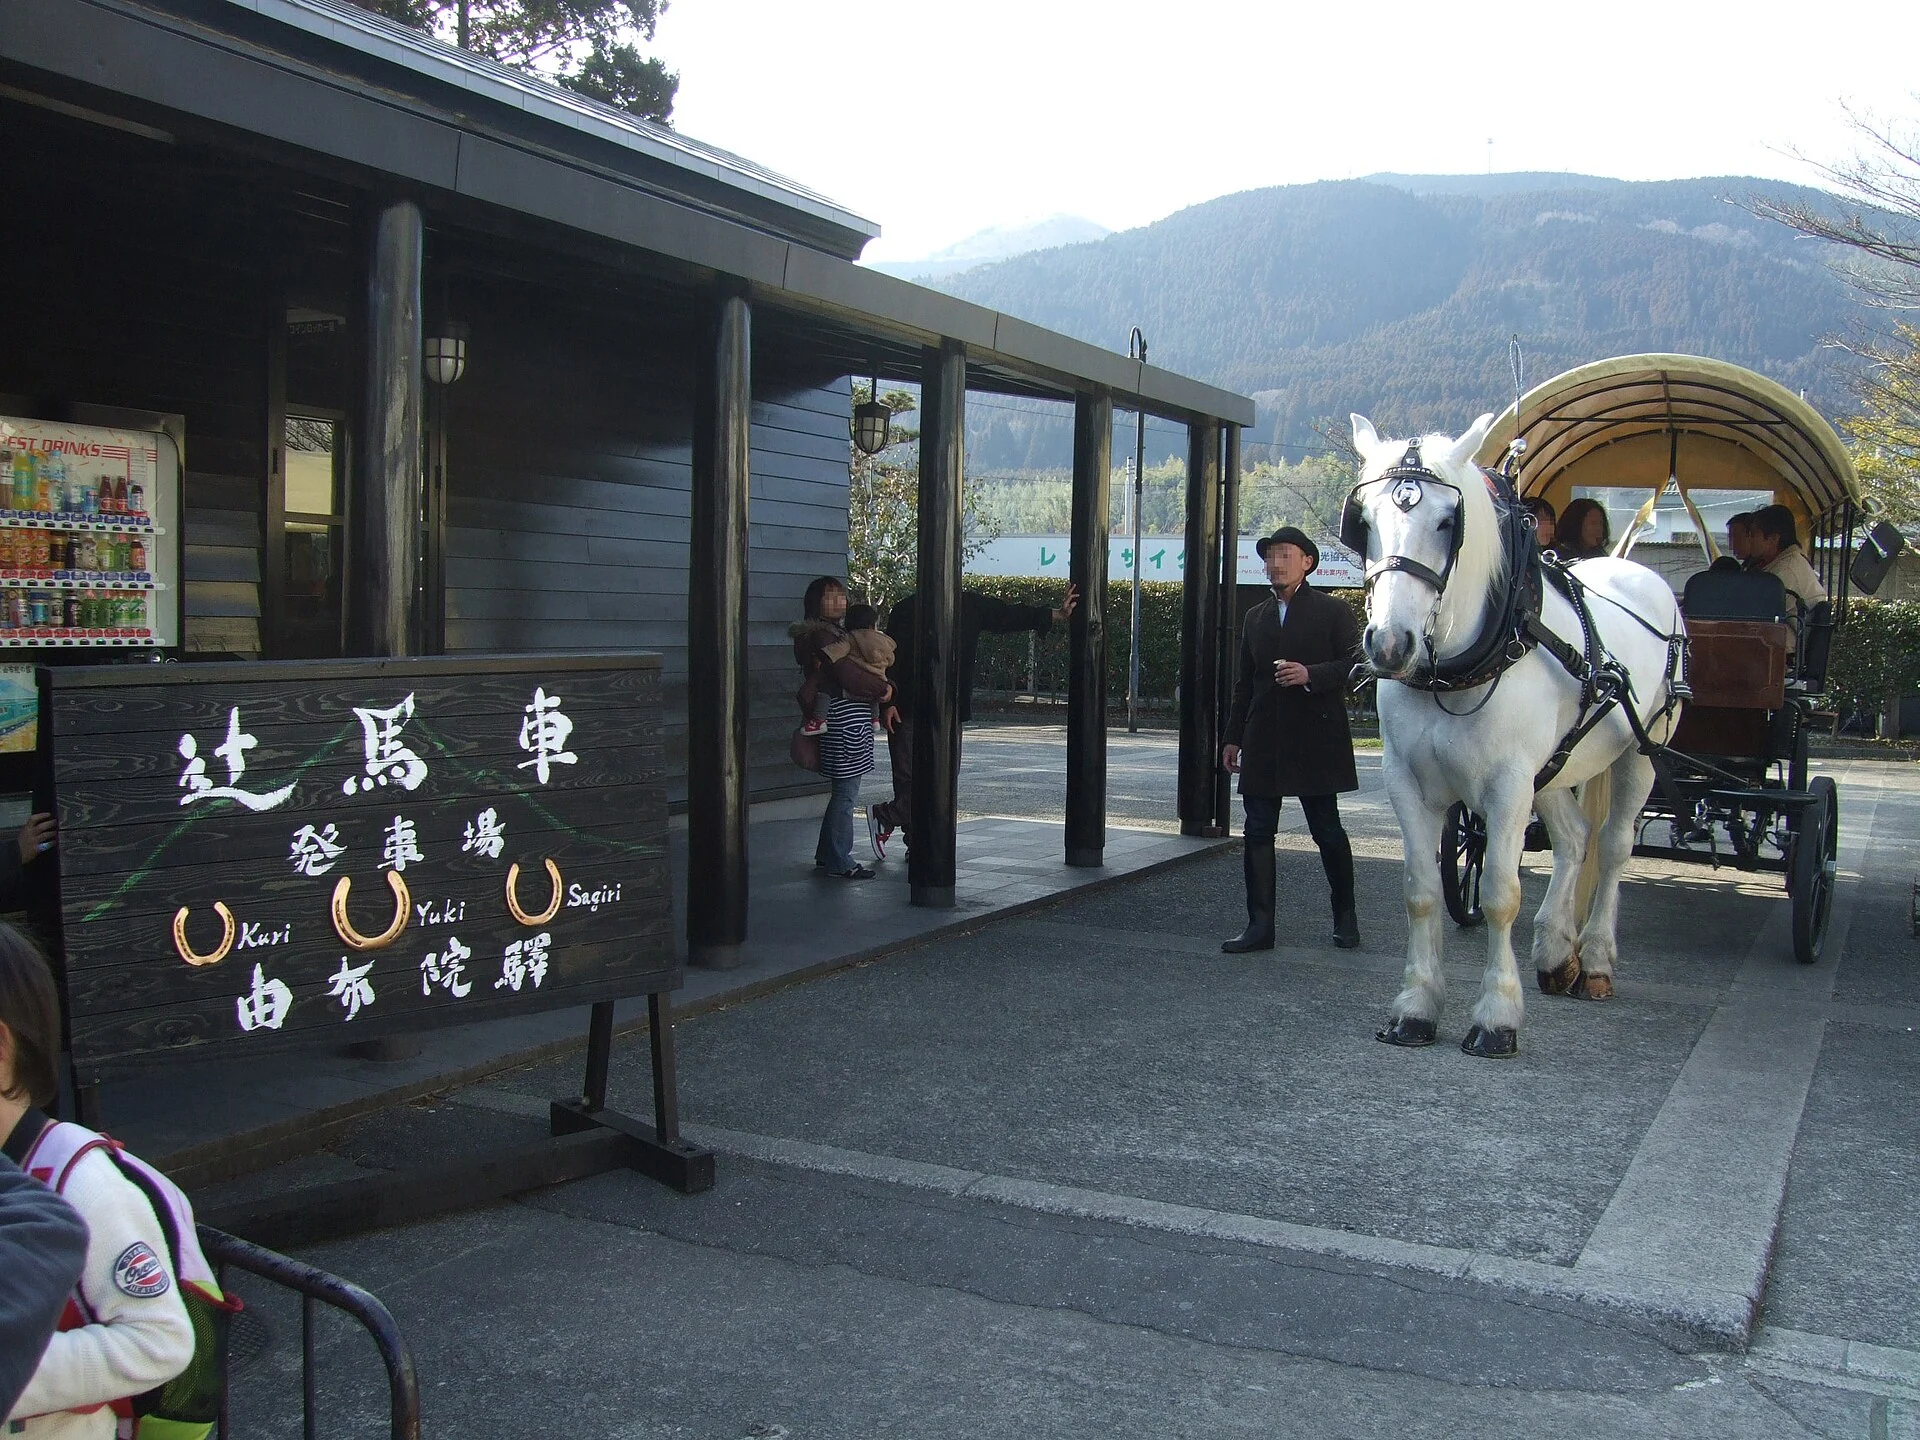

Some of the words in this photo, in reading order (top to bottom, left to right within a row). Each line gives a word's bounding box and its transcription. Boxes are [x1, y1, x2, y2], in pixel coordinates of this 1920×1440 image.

[42, 439, 101, 457] DRINKS
[289, 807, 505, 876] 発車場
[567, 883, 622, 914] Sagiri
[416, 900, 466, 928] Yuki
[236, 922, 292, 951] Kuri
